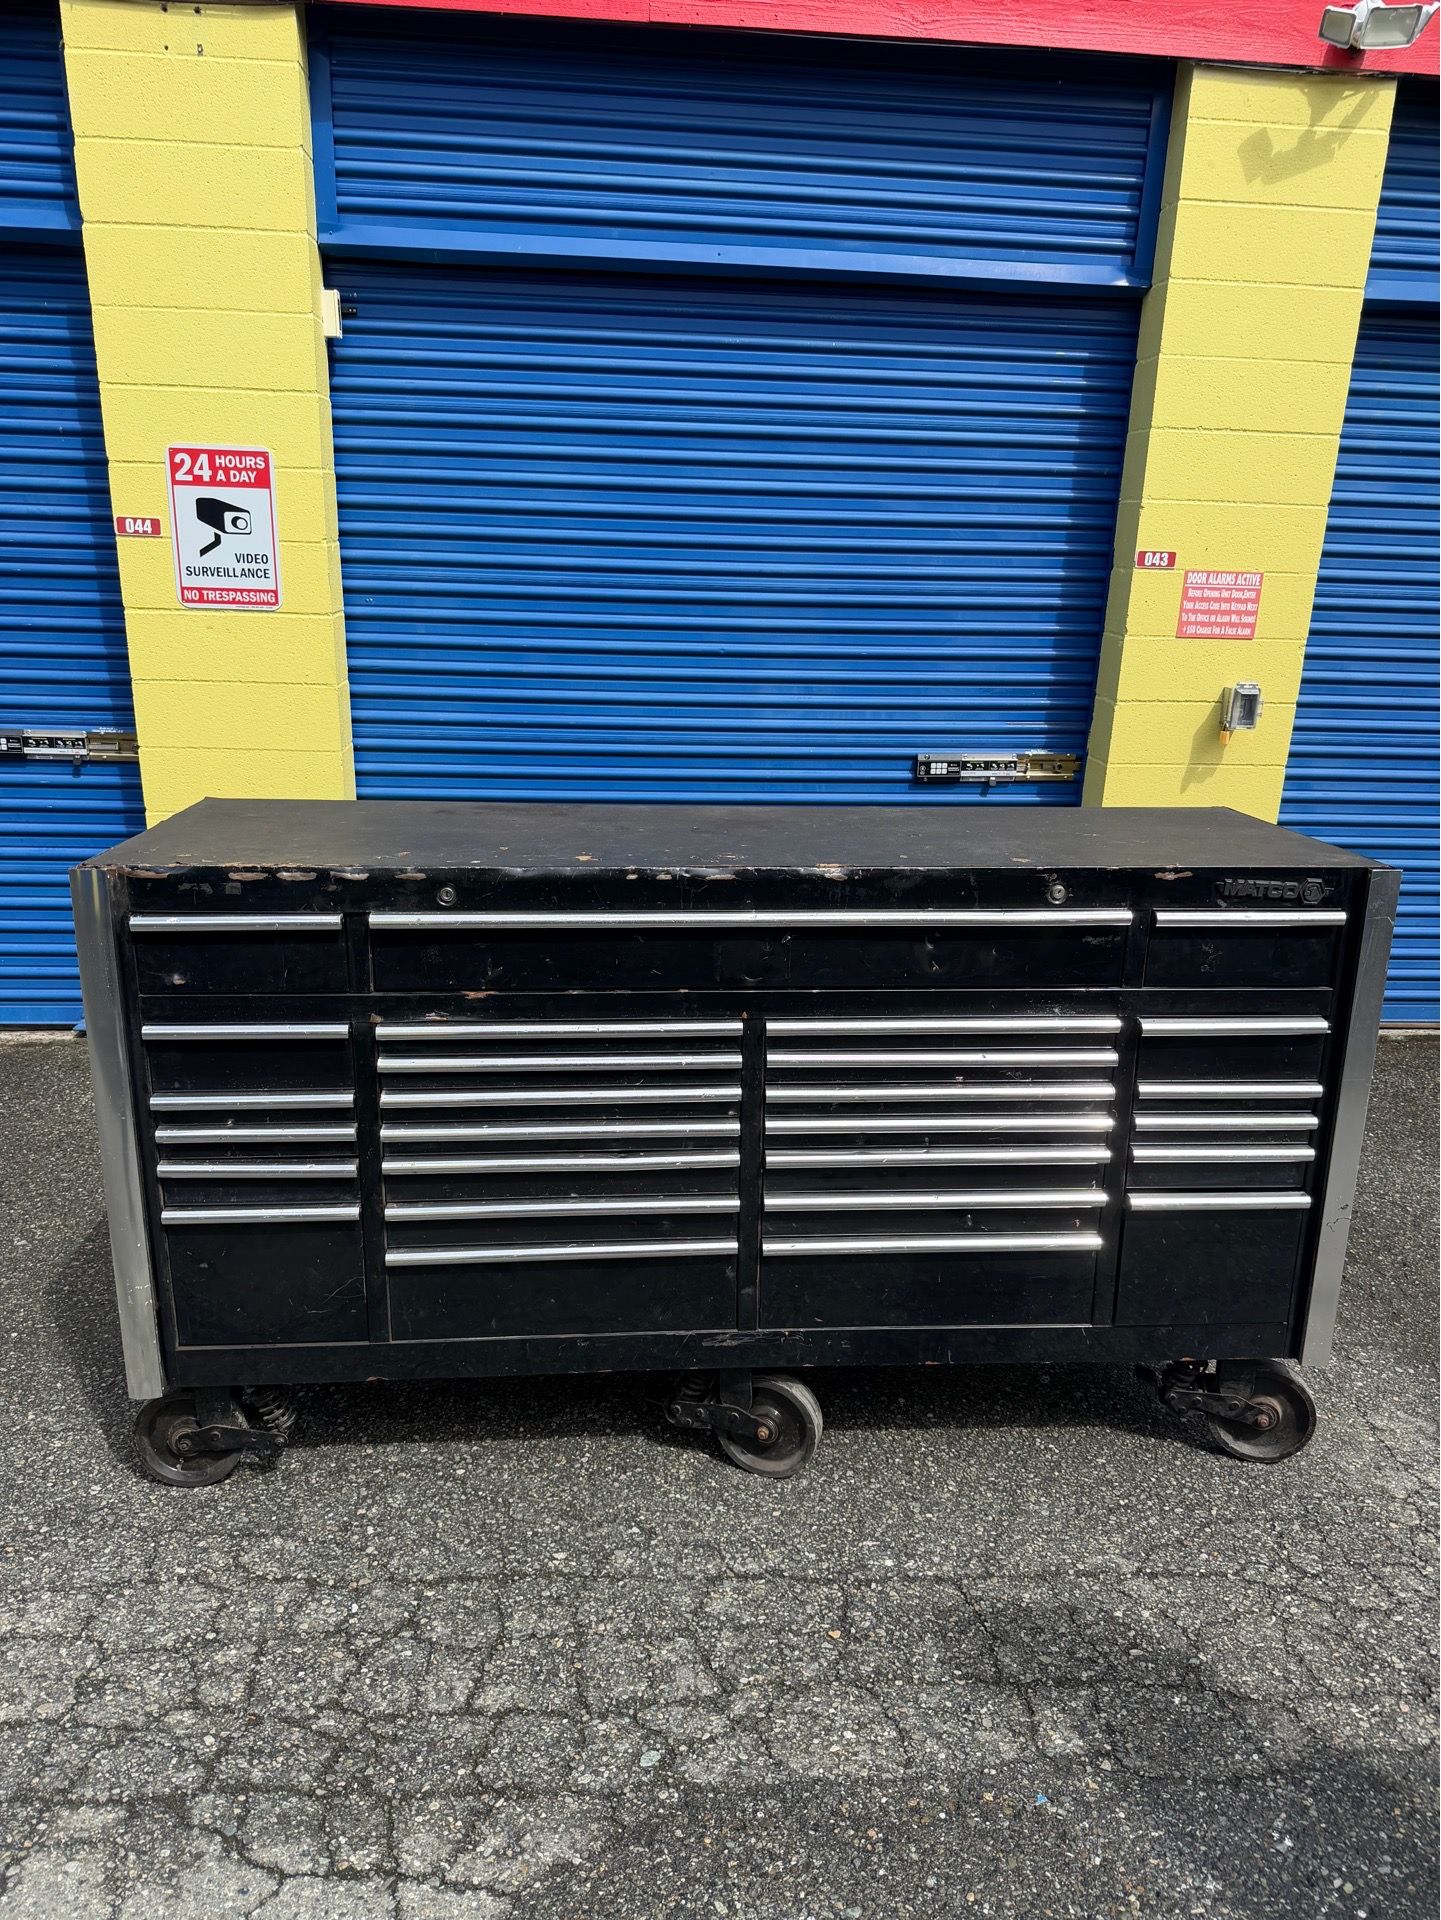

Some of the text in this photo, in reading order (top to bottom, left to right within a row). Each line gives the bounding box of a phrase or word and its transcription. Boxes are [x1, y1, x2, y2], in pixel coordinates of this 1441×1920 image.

[174, 453, 212, 482] 24
[216, 455, 265, 469] HOURS
[216, 471, 257, 483] A DAY
[125, 518, 152, 534] 044
[234, 553, 269, 565] VIDEO
[1144, 552, 1169, 566] 043
[186, 566, 271, 579] SURVEILLANCE
[1187, 572, 1261, 586] DOOR ALARMS ACTIVE
[184, 589, 276, 603] NO TRESPASSING
[1223, 878, 1300, 899] MATCO
